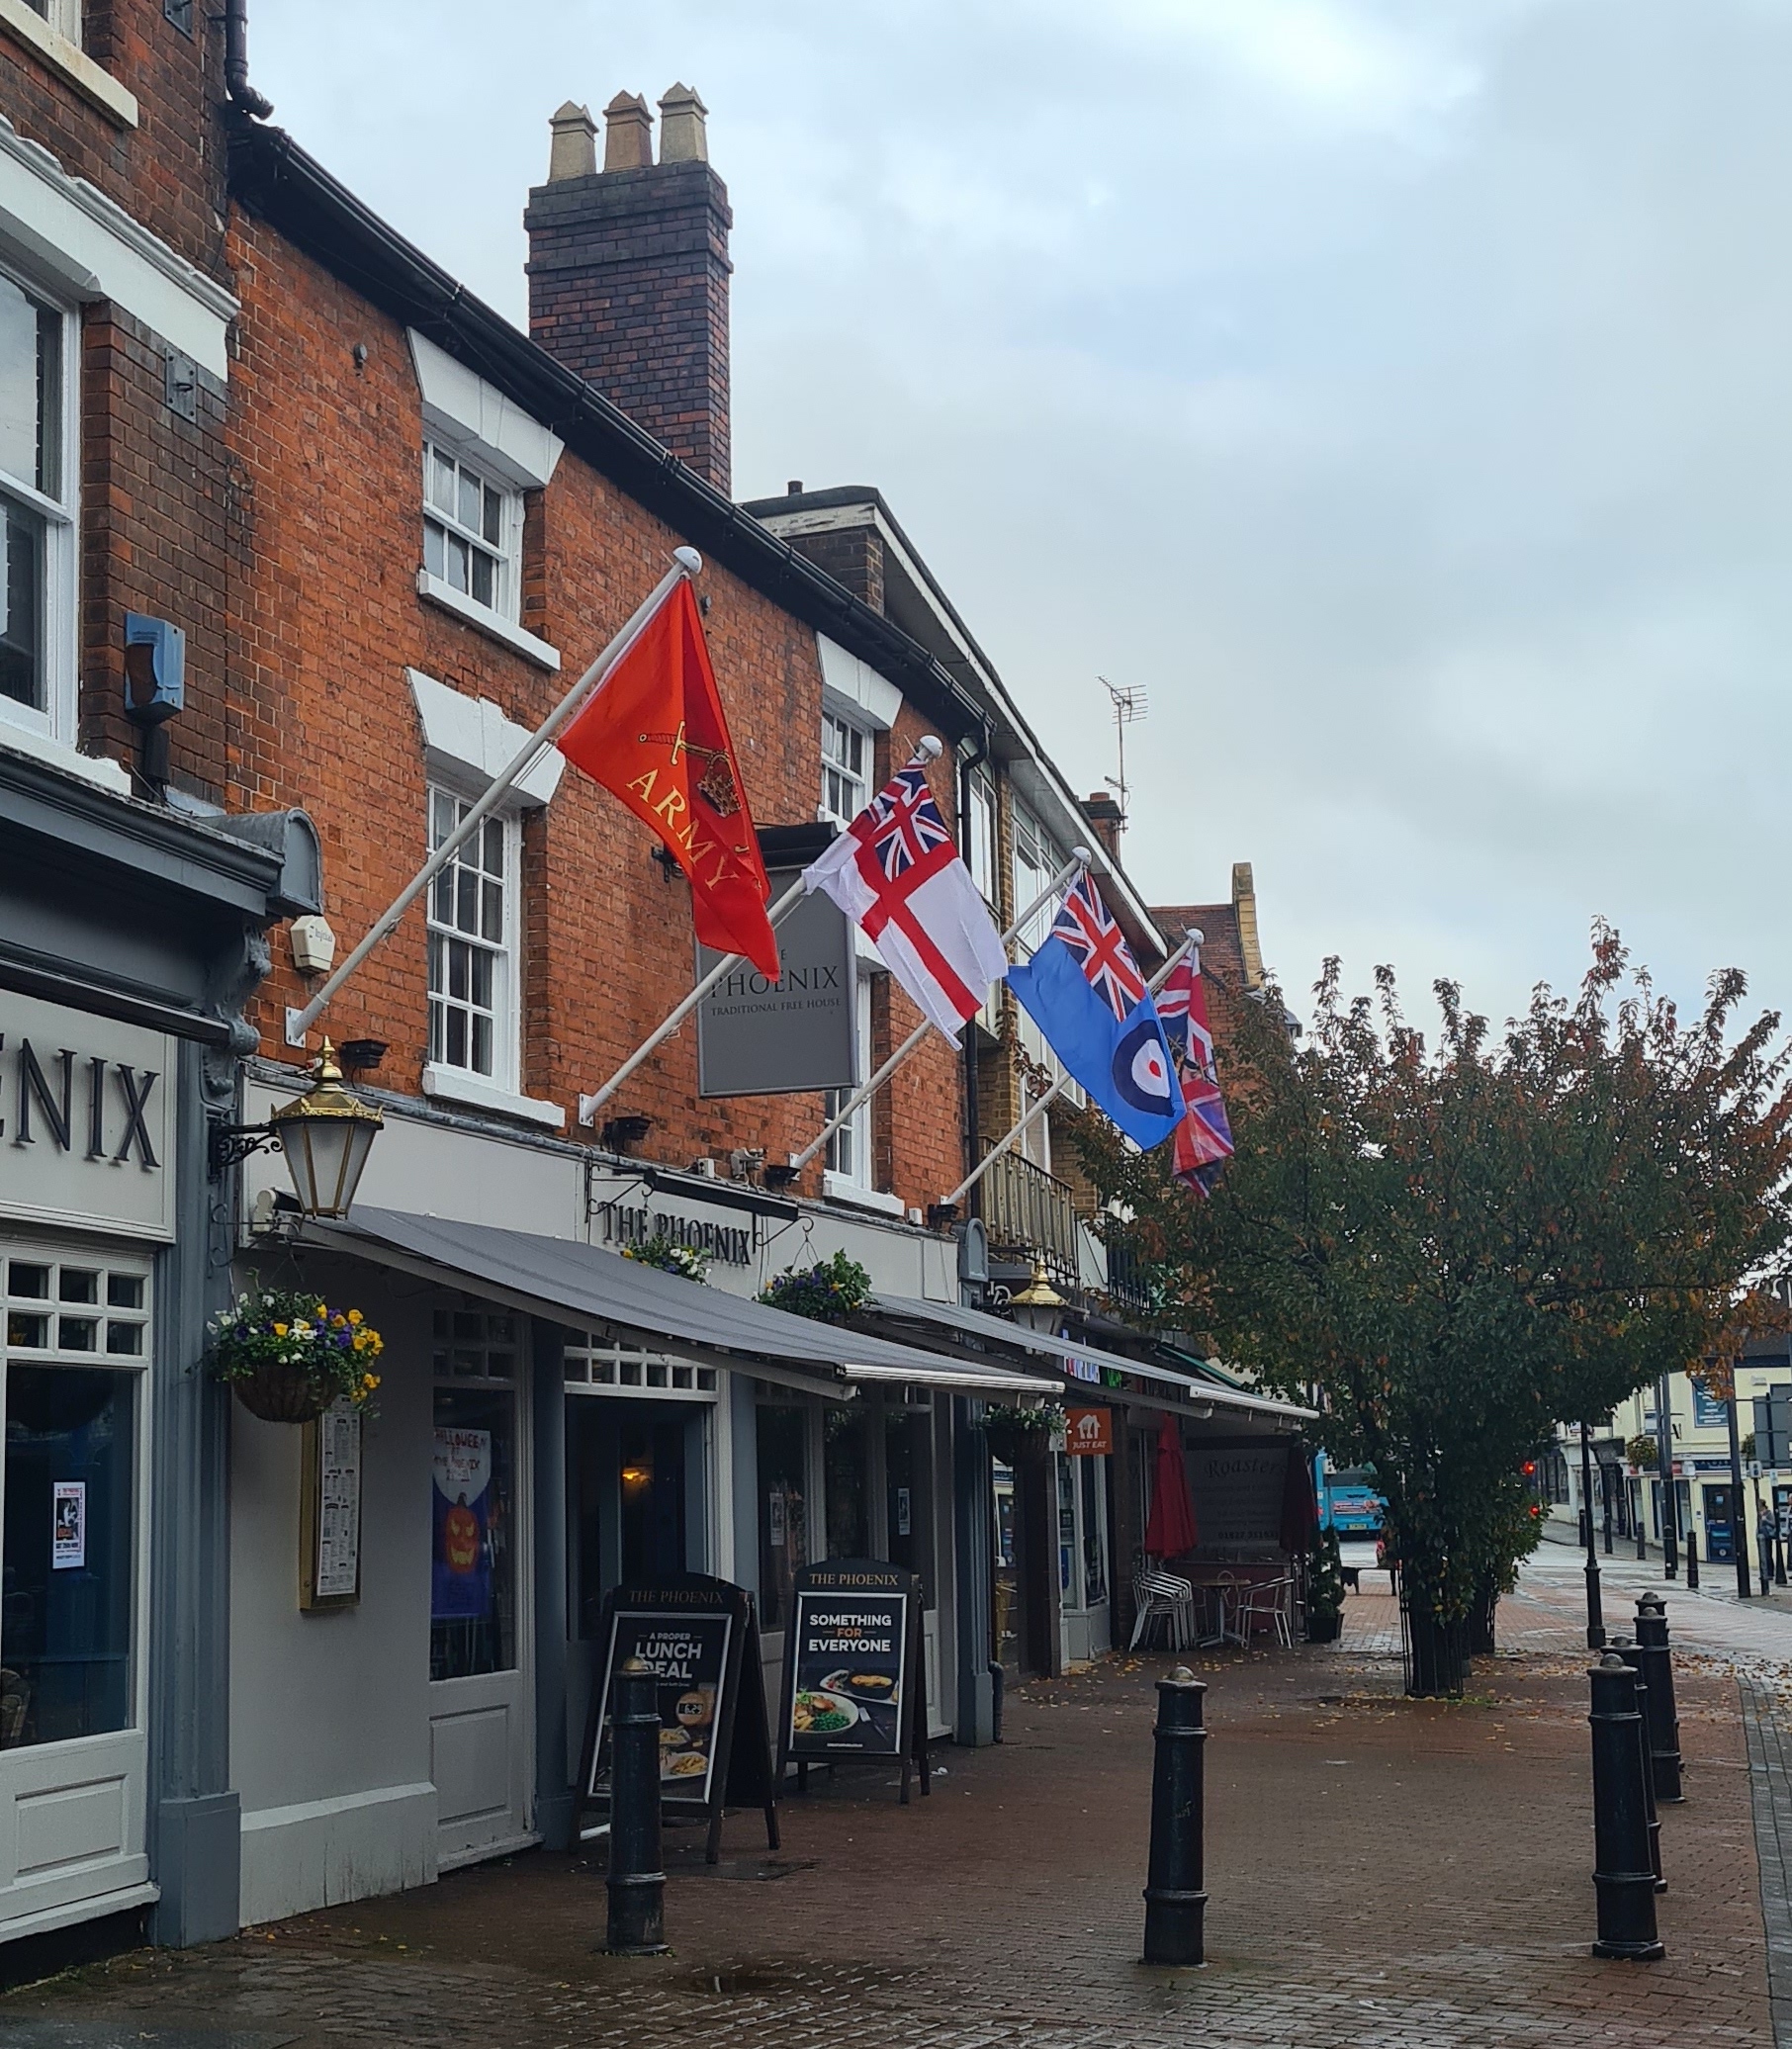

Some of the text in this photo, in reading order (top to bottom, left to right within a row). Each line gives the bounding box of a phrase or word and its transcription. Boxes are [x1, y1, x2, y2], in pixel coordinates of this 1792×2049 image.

[625, 768, 740, 891] ARMY
[712, 998, 841, 1017] TRADITIONAL FREE HOUSE
[0, 1032, 161, 1168] NIX
[599, 1202, 648, 1246] THE
[1072, 1440, 1108, 1450] JUST EAT
[810, 1573, 898, 1586] THE PHOENIX
[629, 1590, 724, 1604] THE PHOENIX
[809, 1614, 892, 1627] SOMETHING
[837, 1629, 862, 1638] FOR
[635, 1642, 702, 1659] LUNCH
[808, 1639, 891, 1651] EVERYONE
